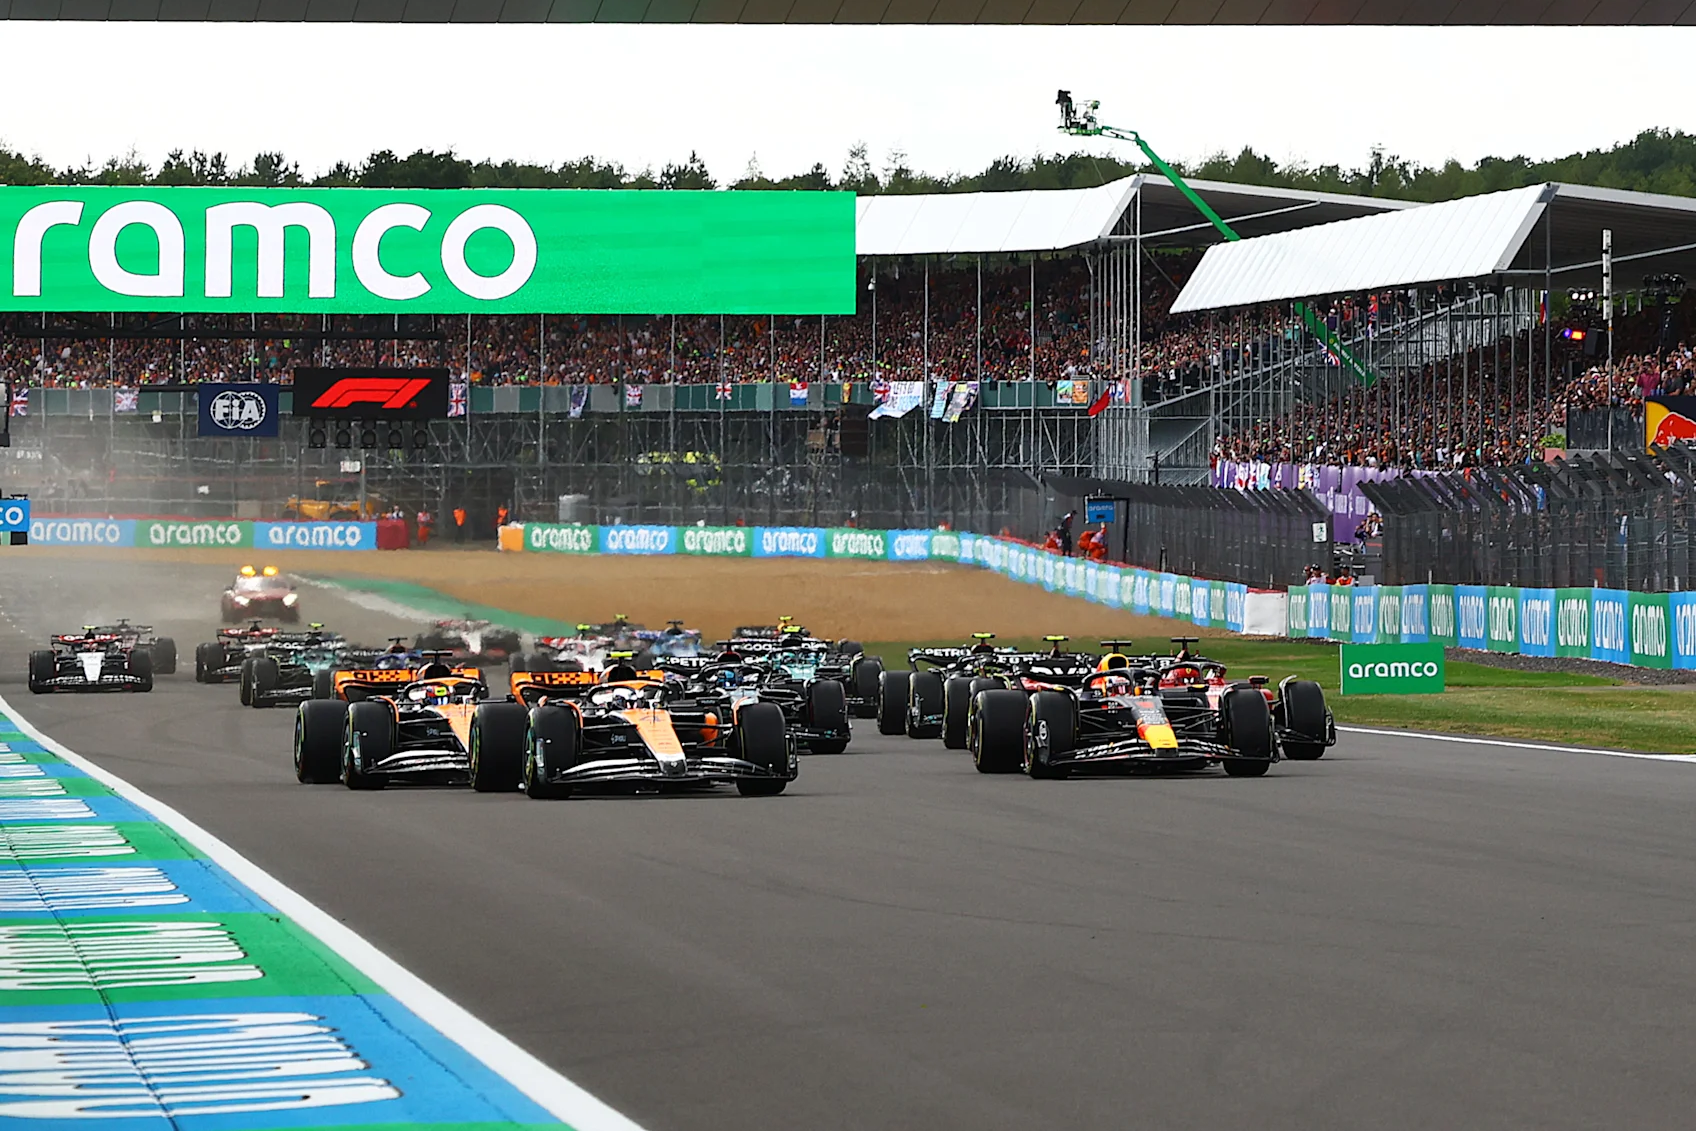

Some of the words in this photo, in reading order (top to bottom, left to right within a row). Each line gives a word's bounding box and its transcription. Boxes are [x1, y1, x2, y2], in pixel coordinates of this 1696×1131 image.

[13, 200, 538, 300] ramco
[31, 521, 120, 544] aramco
[149, 522, 242, 546] aramco
[269, 523, 362, 547] aramco
[531, 526, 591, 551] aramco
[925, 647, 972, 658] PETRO
[1348, 661, 1438, 679] aramco
